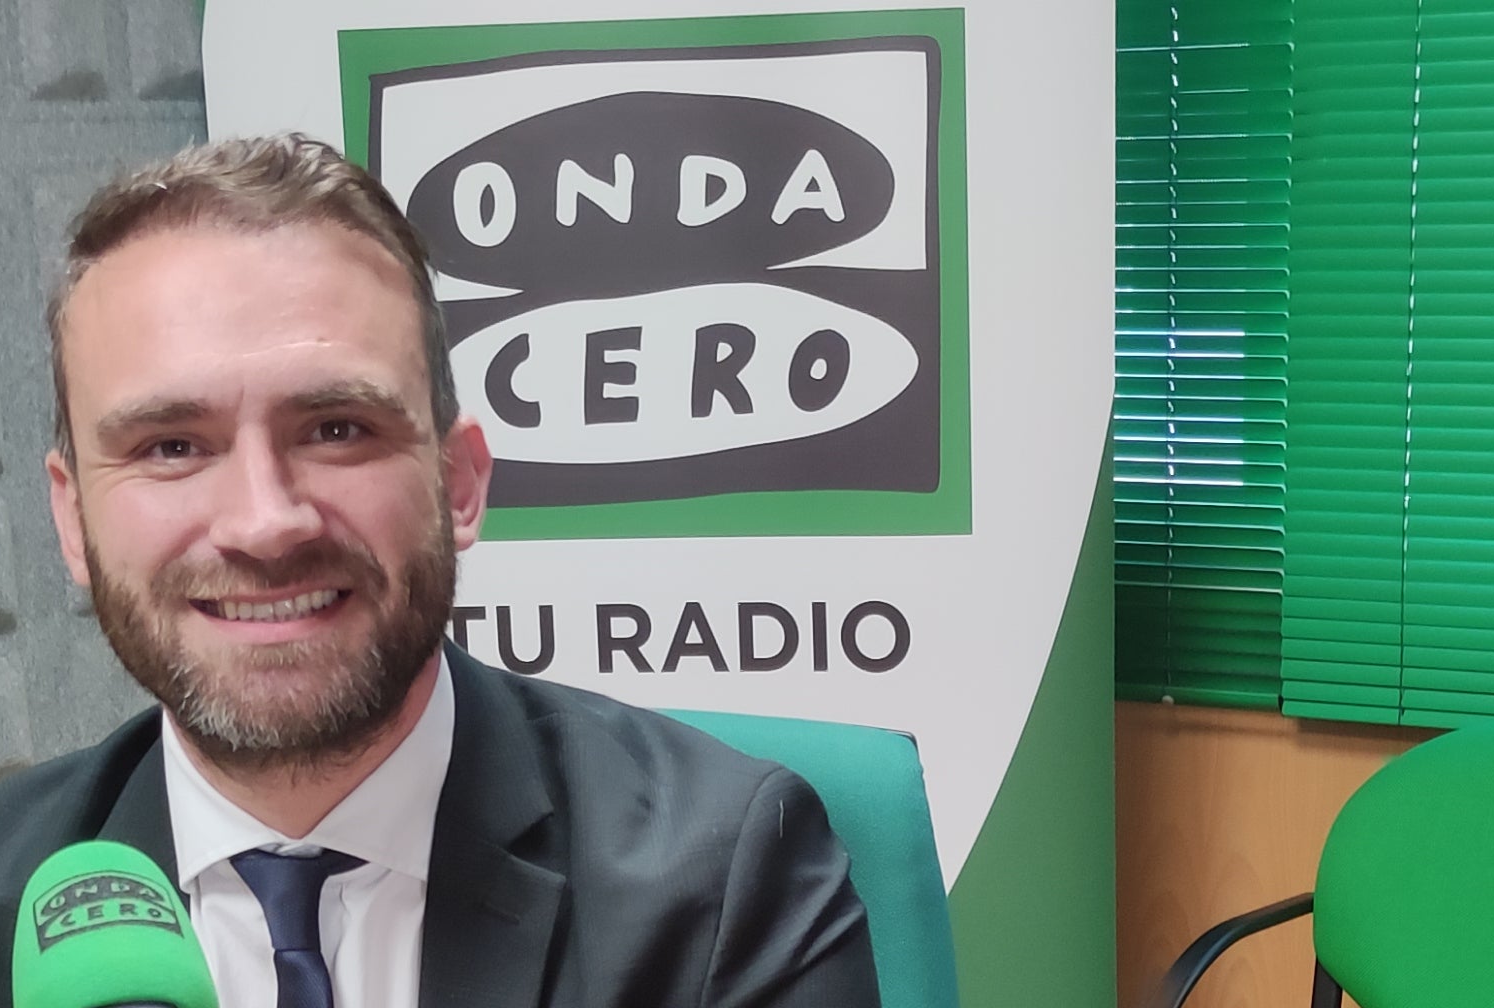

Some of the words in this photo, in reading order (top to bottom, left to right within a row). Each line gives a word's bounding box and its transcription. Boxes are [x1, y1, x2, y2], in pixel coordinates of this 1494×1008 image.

[452, 148, 846, 248] ONDA
[483, 321, 851, 430] CERO
[451, 604, 556, 675] TU
[595, 600, 912, 674] RADIO
[49, 881, 156, 909] ONDA
[59, 903, 163, 927] CERO
